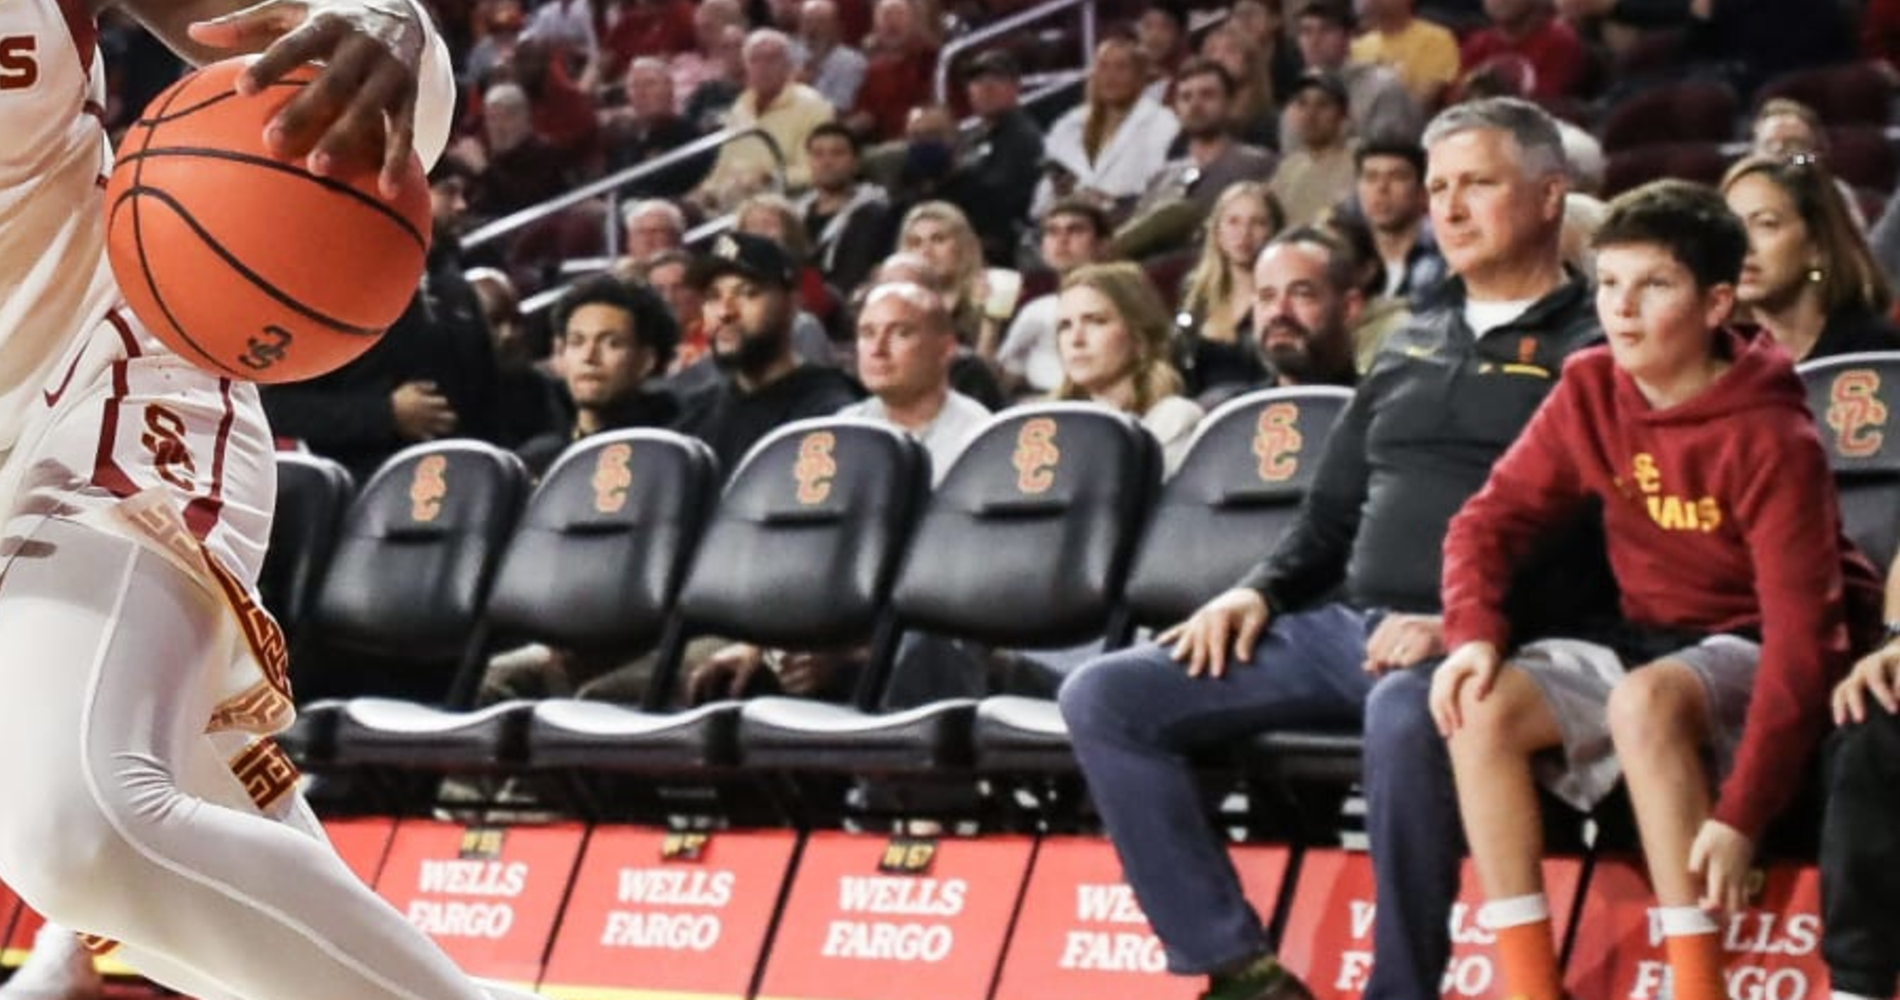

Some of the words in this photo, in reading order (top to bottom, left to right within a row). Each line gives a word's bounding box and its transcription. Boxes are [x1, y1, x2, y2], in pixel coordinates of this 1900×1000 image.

[418, 859, 528, 897] WELLS
[617, 868, 736, 908] WELLS
[839, 874, 968, 916] WELLS
[406, 899, 514, 939] FARGO
[600, 910, 722, 952] FARGO
[821, 920, 953, 962] FARGO
[1057, 930, 1168, 973] FARG
